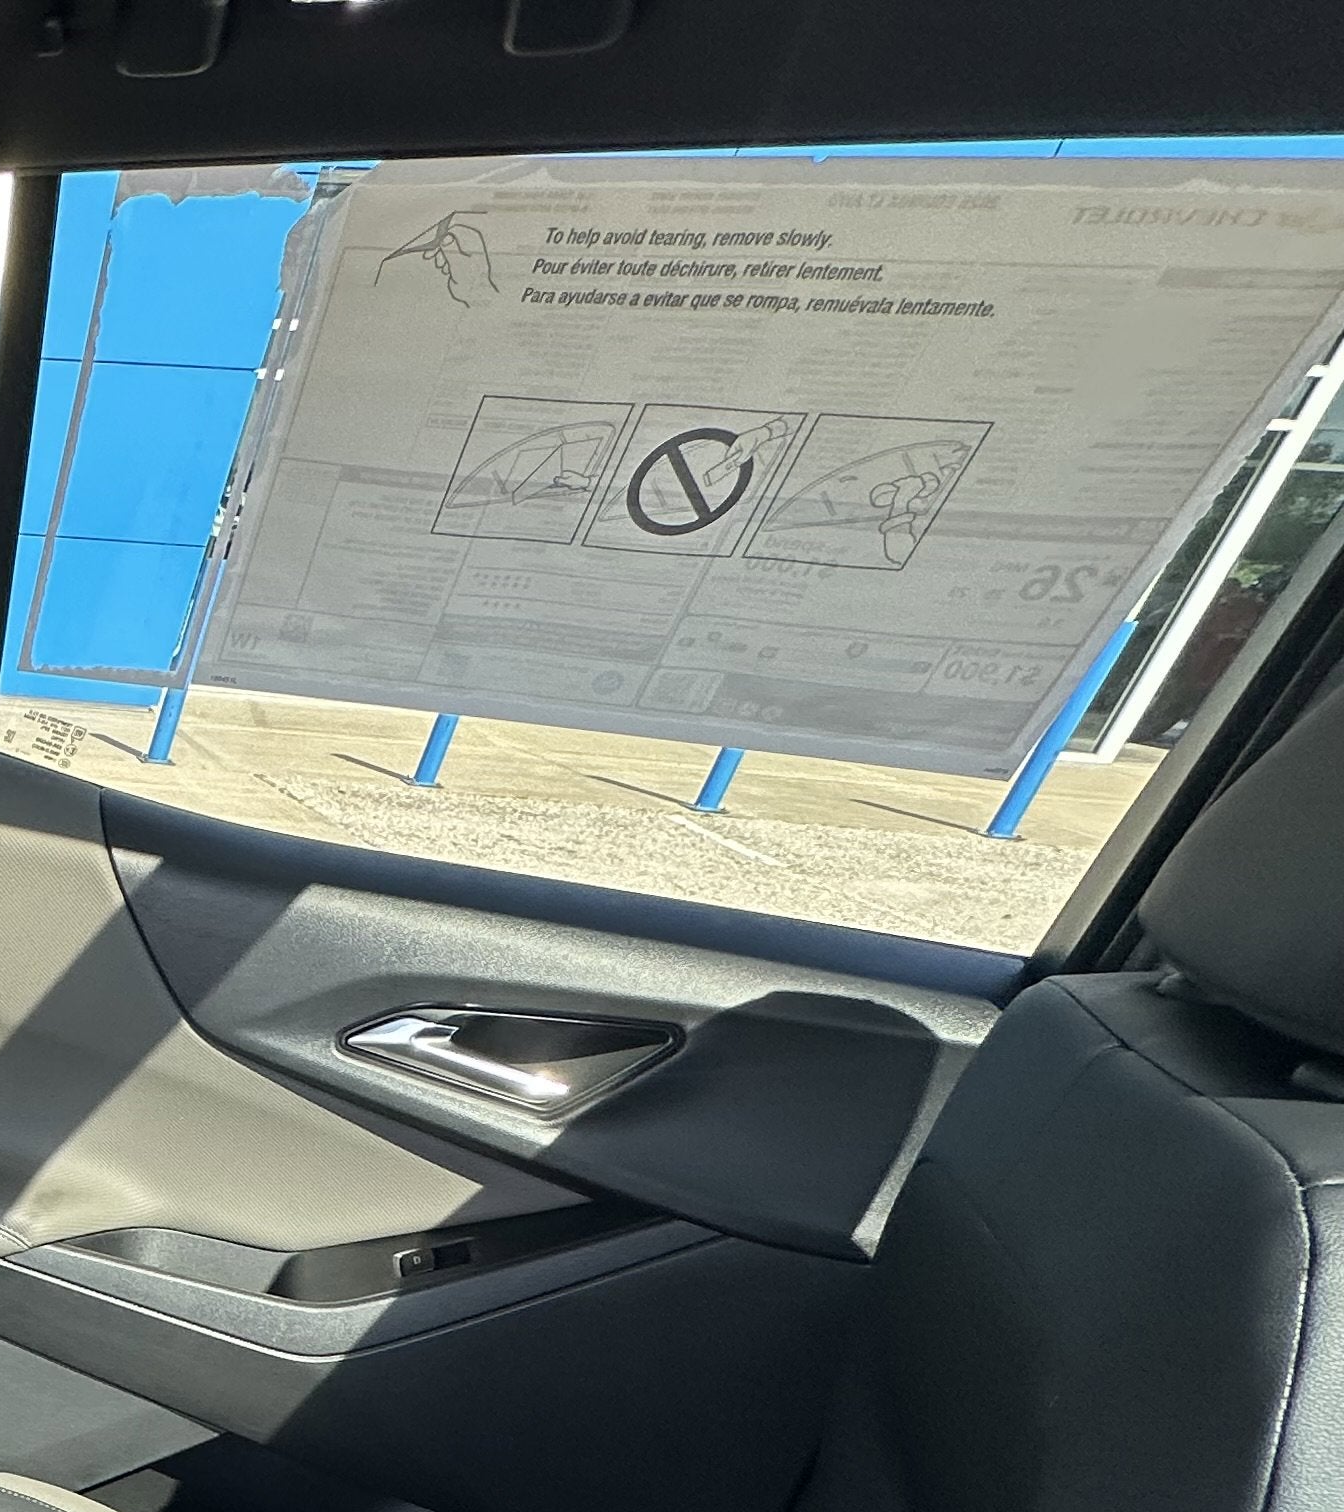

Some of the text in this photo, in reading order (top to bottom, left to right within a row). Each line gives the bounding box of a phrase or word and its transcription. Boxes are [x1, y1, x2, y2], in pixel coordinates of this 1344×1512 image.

[545, 227, 834, 252] To help avoid tearing, remove slowly.
[531, 257, 884, 282] Pour éviter toute déchirure, retirer lentement.
[520, 287, 556, 304] Para
[557, 288, 627, 307] ayudarse
[628, 292, 641, 307] a
[642, 290, 690, 308] evitar
[689, 293, 722, 311] que
[722, 294, 743, 309] se
[745, 293, 802, 314] rompa,
[894, 297, 996, 319] lentamente.
